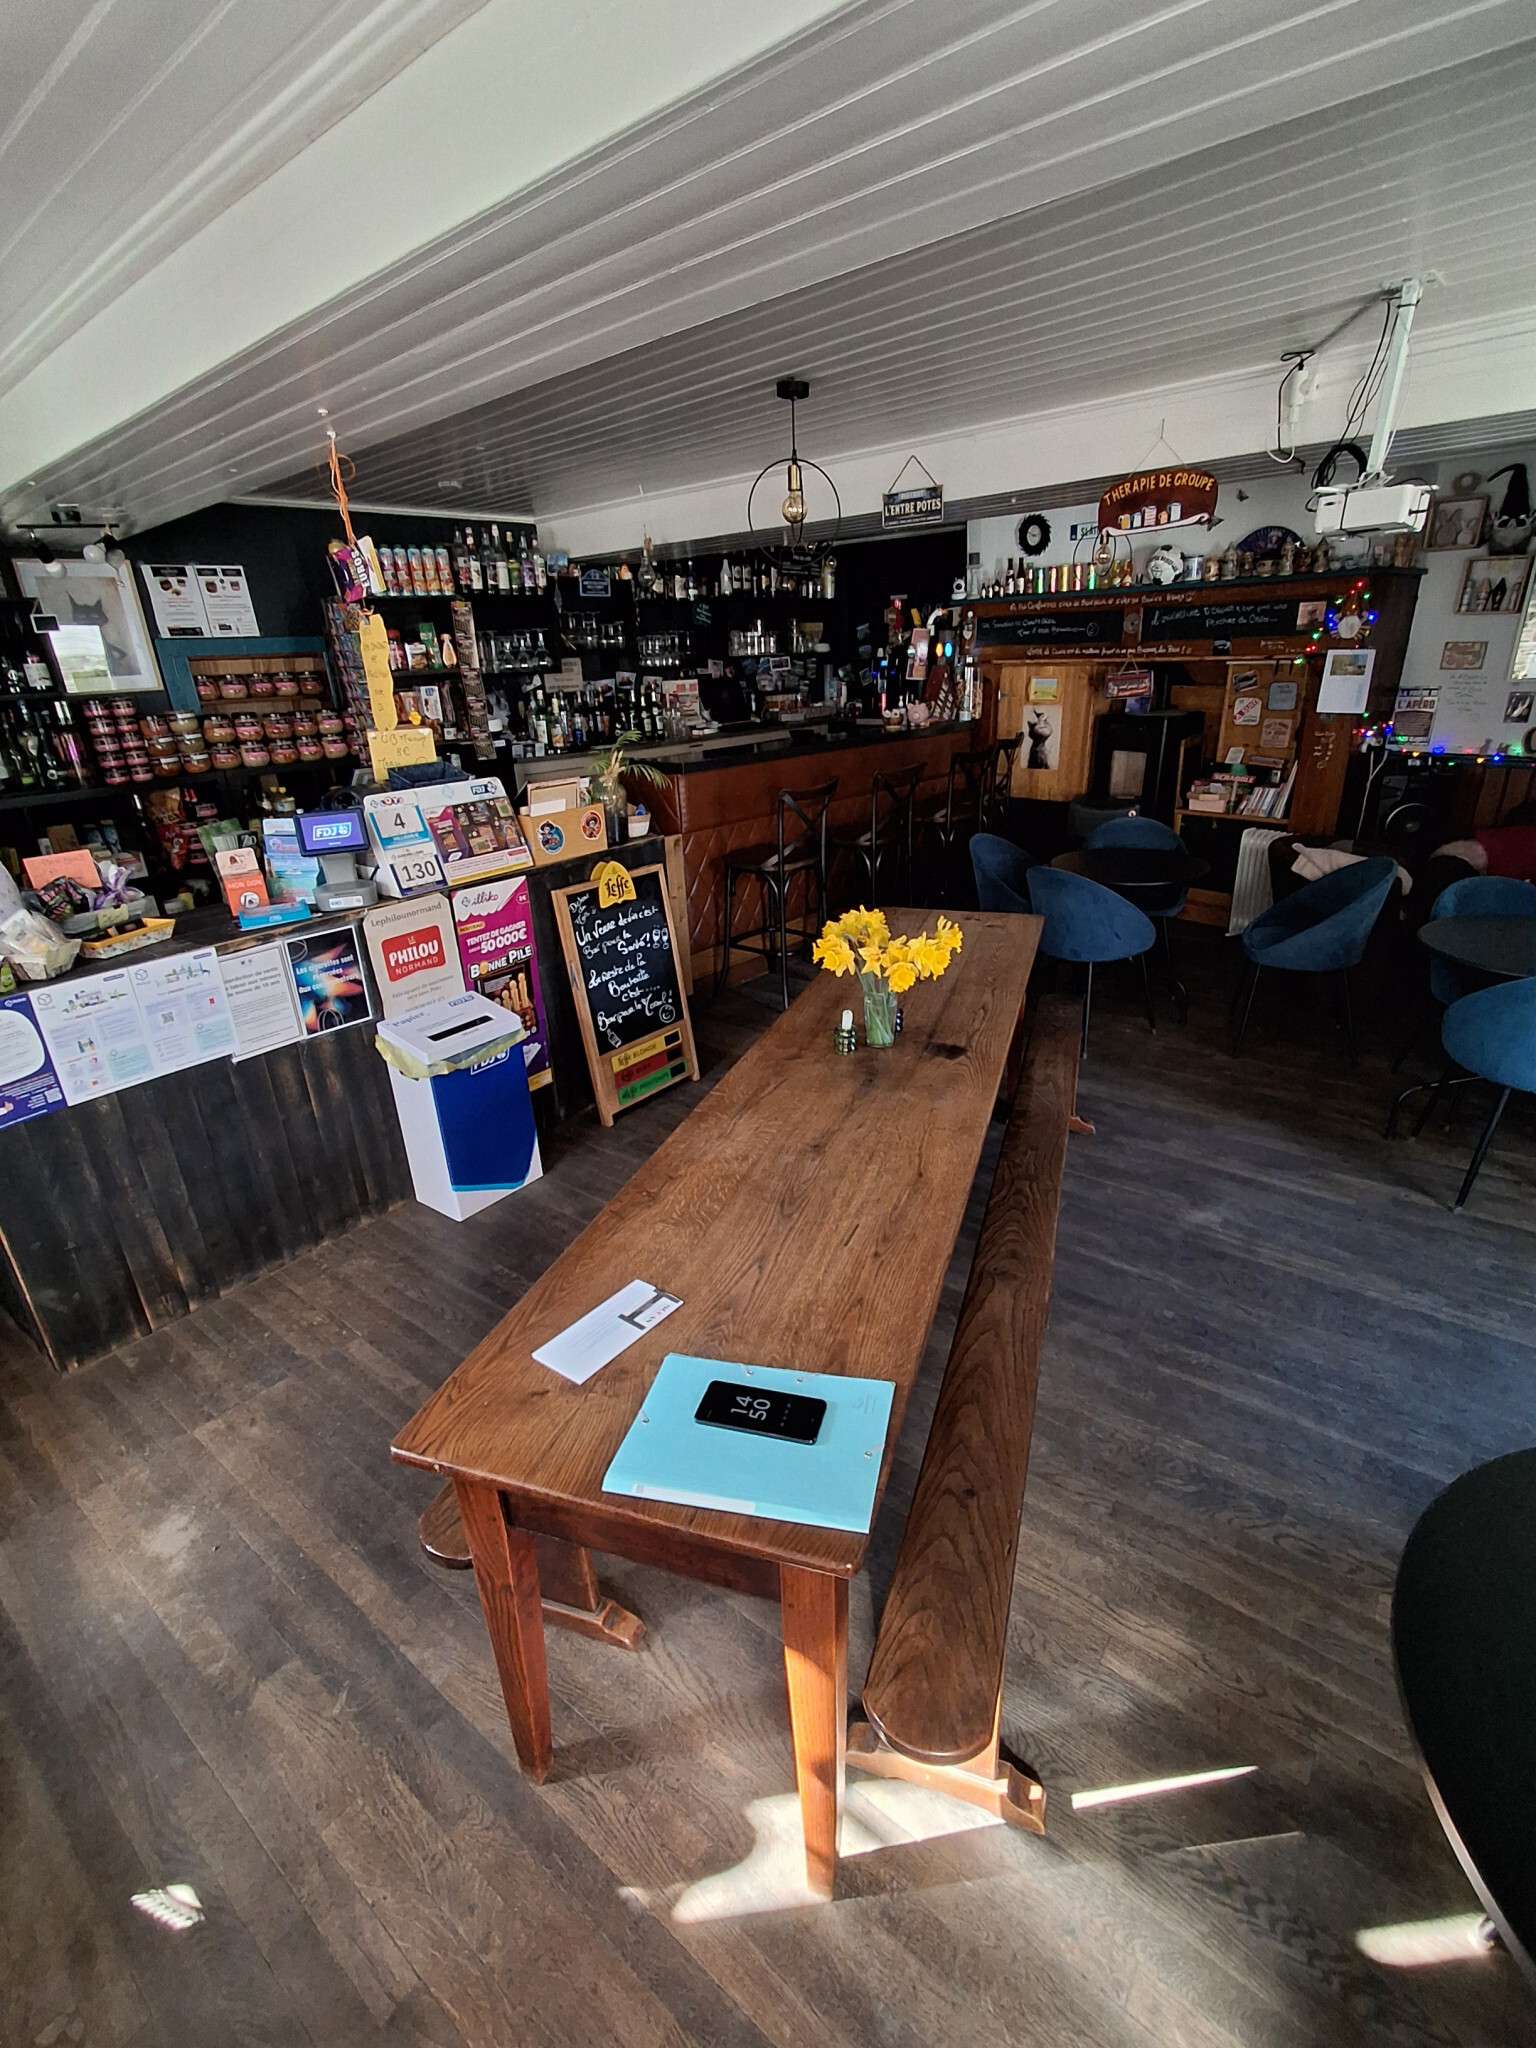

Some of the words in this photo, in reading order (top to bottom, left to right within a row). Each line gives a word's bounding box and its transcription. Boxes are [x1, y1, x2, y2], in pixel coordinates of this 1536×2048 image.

[1103, 474, 1156, 505] THERAPIE
[1159, 474, 1171, 488] DE
[1173, 472, 1215, 491] GROUPE
[885, 502, 915, 516] L'ENTRE
[916, 498, 941, 513] POTES
[472, 785, 486, 794] FDJ
[394, 812, 406, 829] 4
[316, 827, 338, 838] FDJ
[402, 860, 436, 882] 130
[466, 932, 490, 946] TENTEZ
[490, 928, 500, 938] DE
[499, 920, 526, 934] GAGNER
[388, 940, 439, 967] PHILOU
[470, 956, 508, 979] BONNE
[508, 945, 532, 964] PILE
[394, 956, 440, 976] NORMAND
[730, 1395, 752, 1414] 14
[748, 1398, 771, 1421] 50
